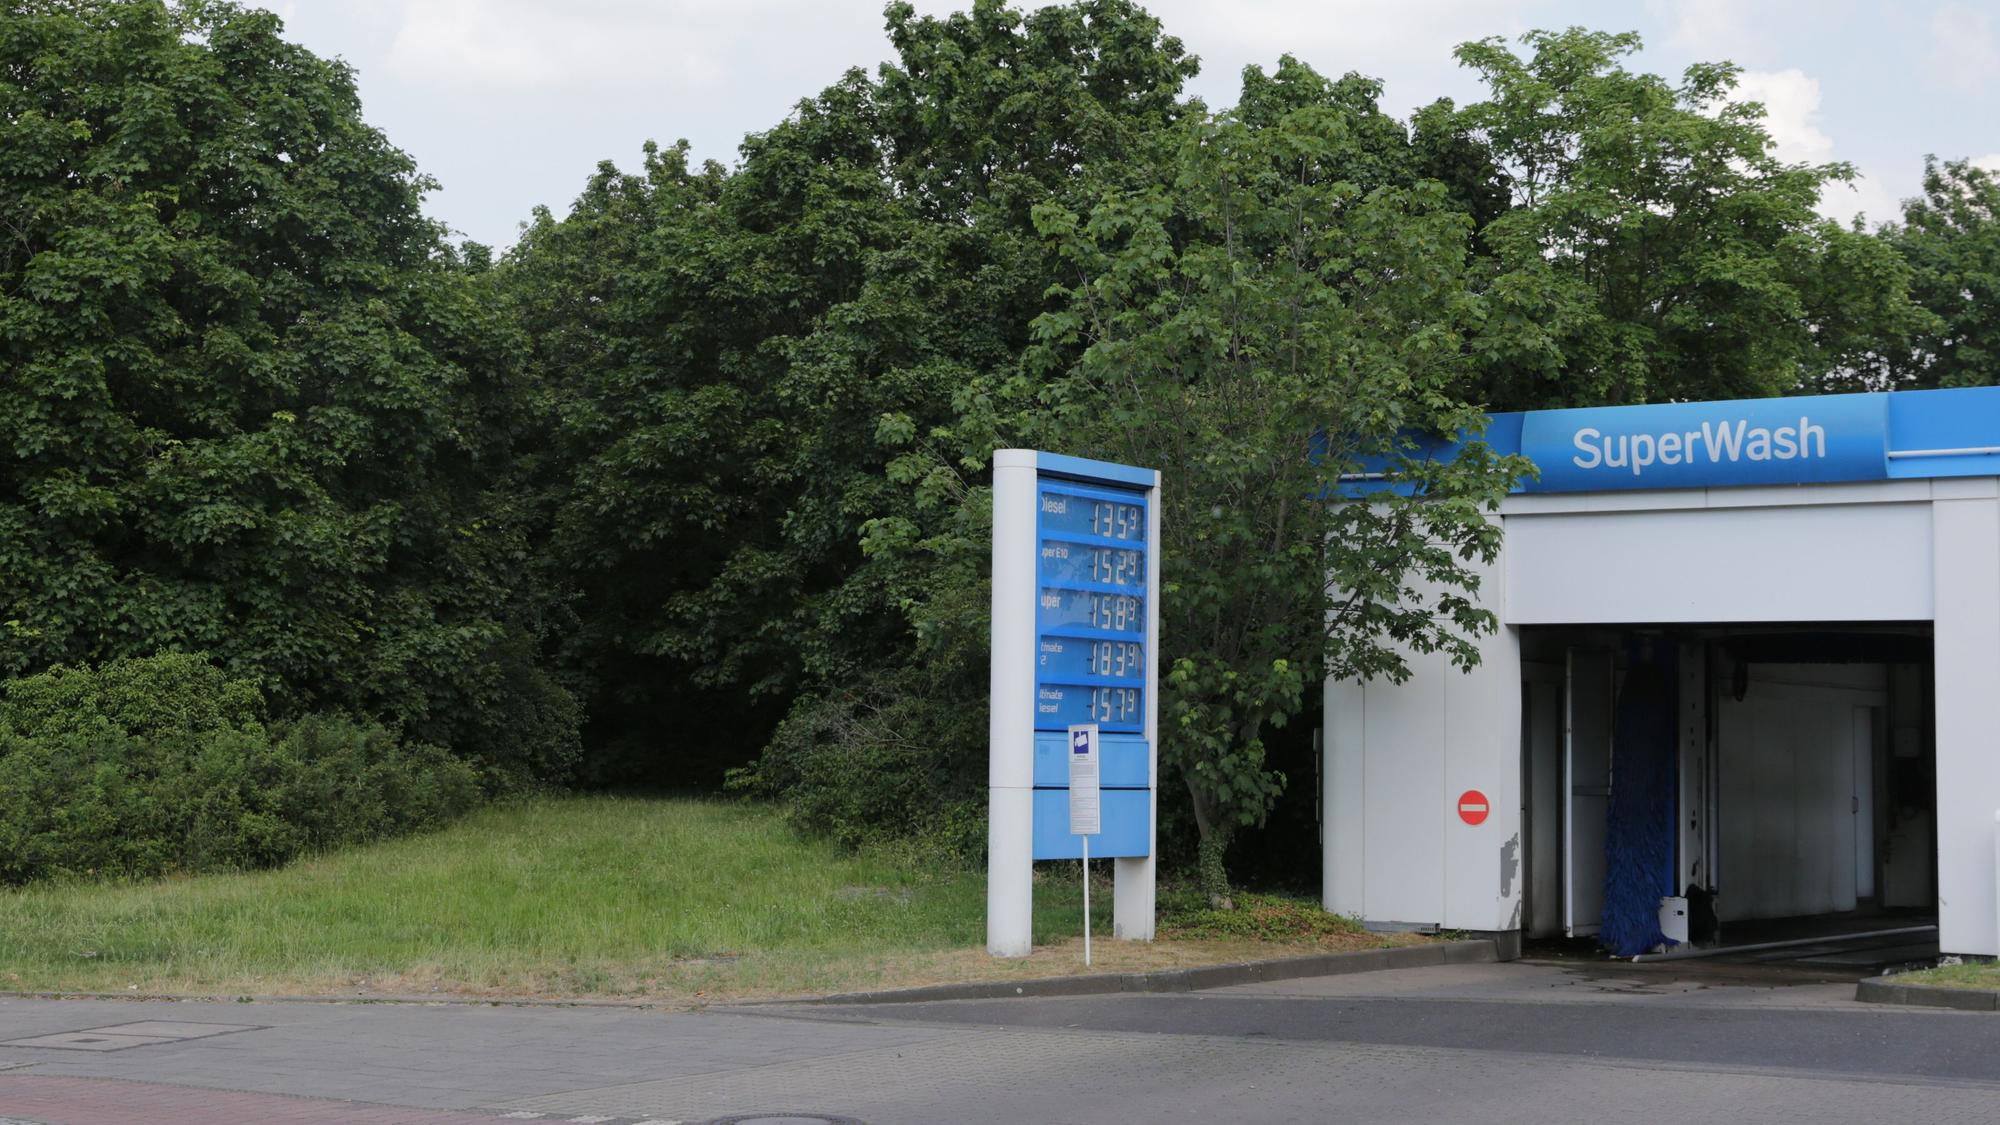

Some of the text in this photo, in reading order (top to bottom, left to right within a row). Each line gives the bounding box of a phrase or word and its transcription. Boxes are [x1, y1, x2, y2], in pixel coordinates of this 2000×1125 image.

[1573, 416, 1826, 476] SuperWash
[1093, 503, 1137, 539] 1359
[1093, 551, 1137, 585] 1529
[1092, 641, 1136, 676] 1839
[1091, 687, 1135, 721] 1579
